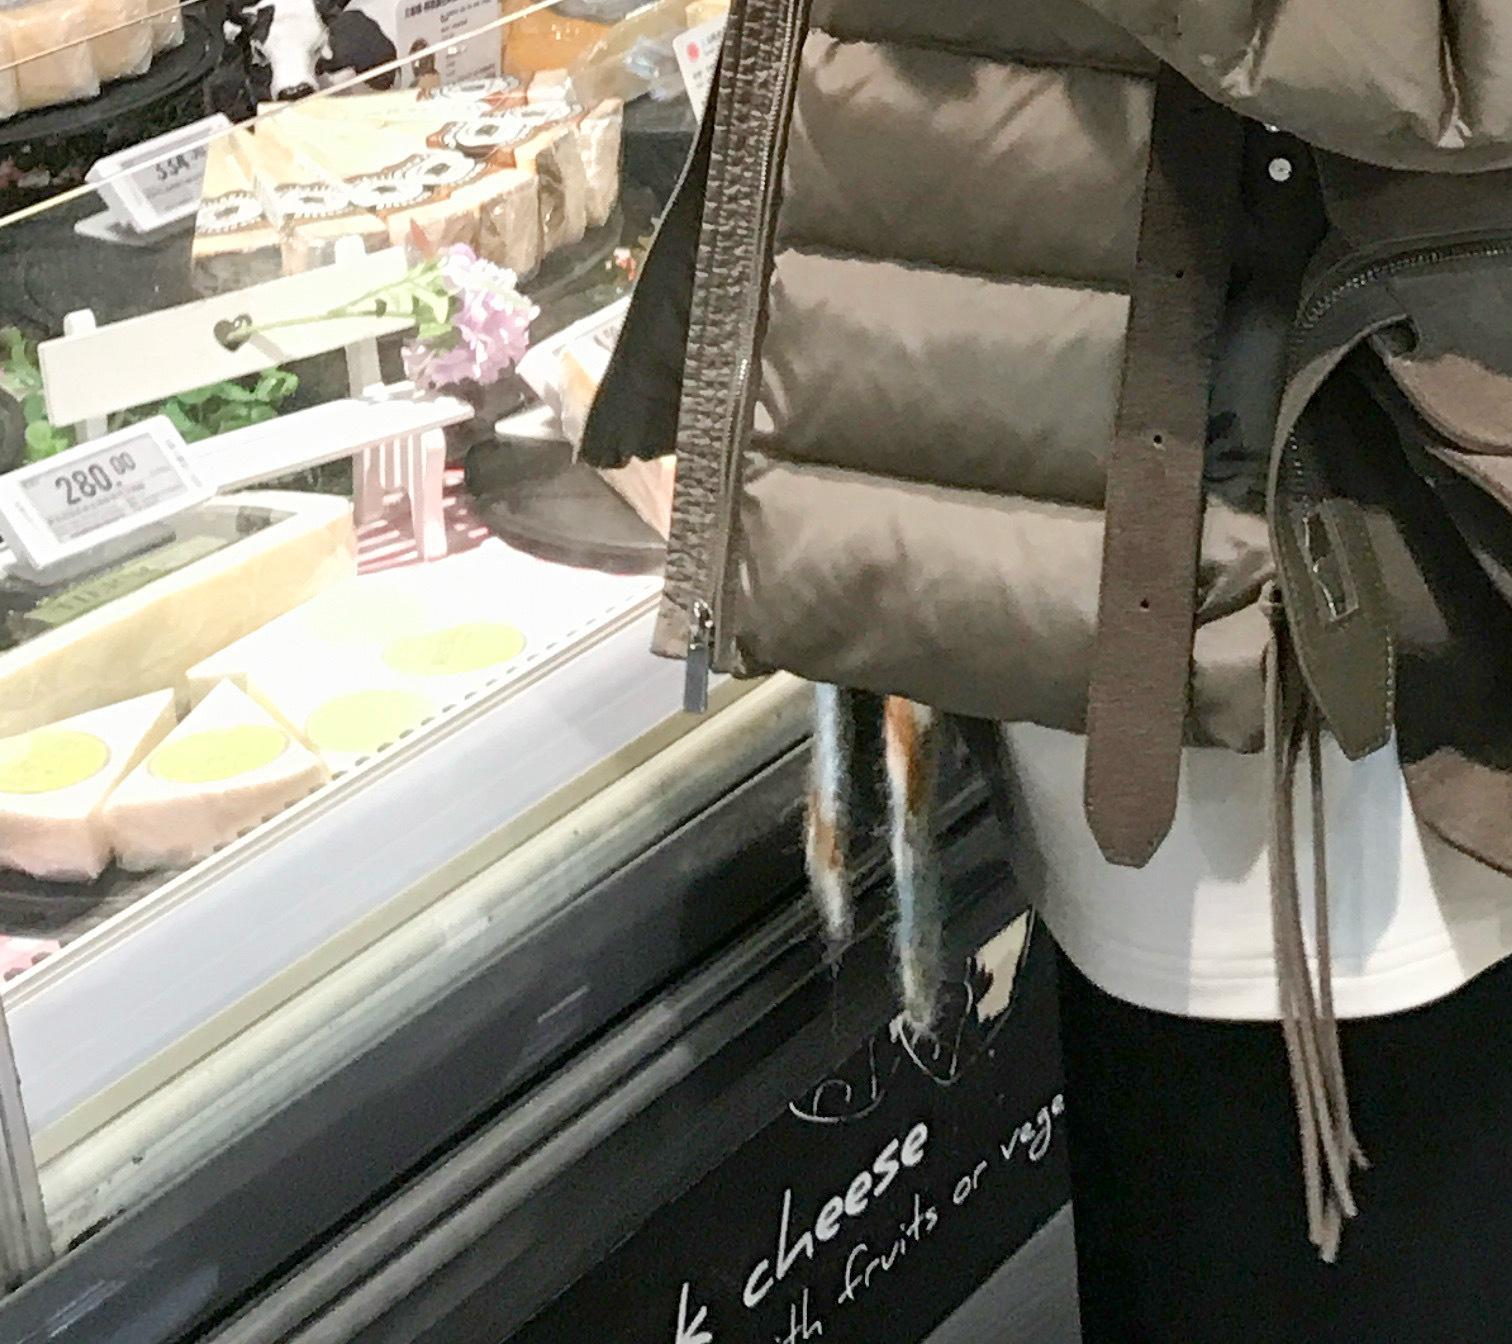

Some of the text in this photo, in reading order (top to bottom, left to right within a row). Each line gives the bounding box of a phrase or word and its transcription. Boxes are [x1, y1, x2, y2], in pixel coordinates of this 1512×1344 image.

[742, 1122, 929, 1309] cheese
[838, 1193, 939, 1304] fruits
[951, 1160, 988, 1205] or
